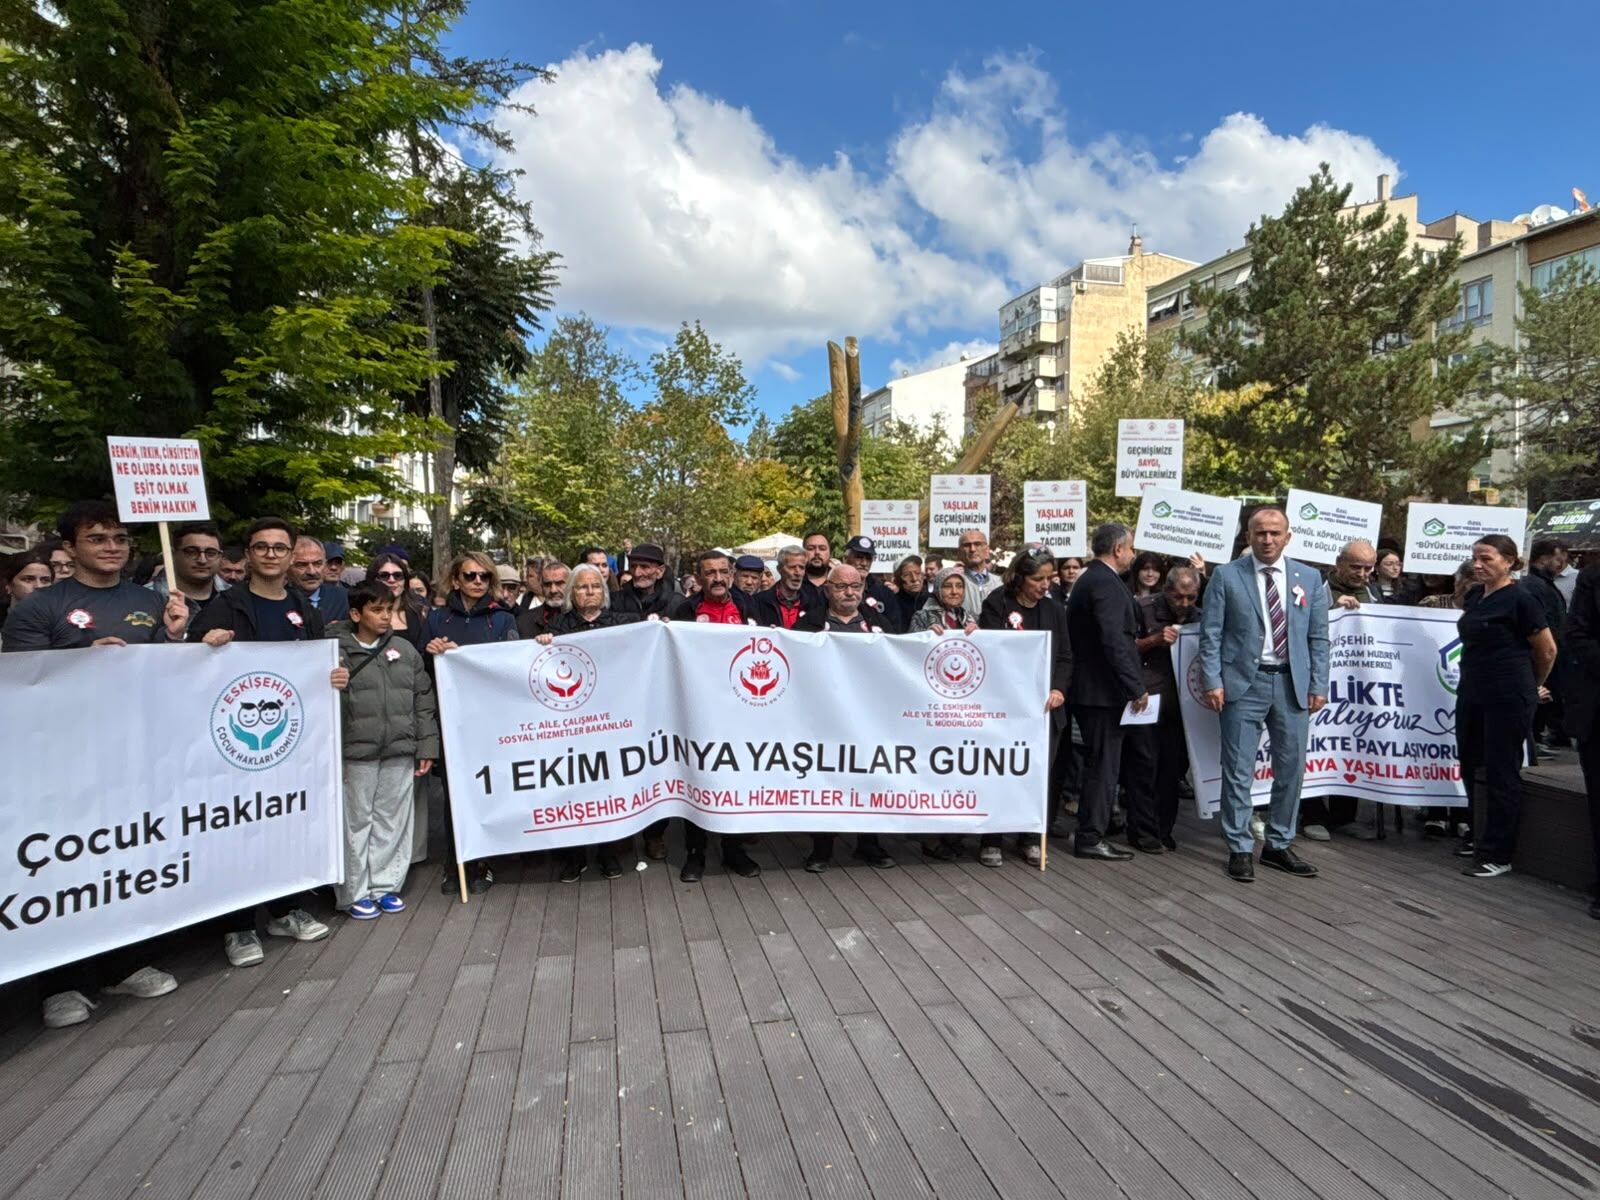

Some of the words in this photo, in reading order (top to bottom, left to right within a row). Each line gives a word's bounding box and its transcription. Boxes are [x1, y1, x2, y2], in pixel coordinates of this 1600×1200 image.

[1127, 445, 1173, 457] GEÇMİŞİMİZE
[116, 462, 130, 475] NE
[131, 463, 168, 475] OLURSA
[170, 463, 199, 476] OLSUN
[1121, 468, 1177, 479] BÜYÜKLERİMİZE
[134, 479, 155, 496] EŞİT
[157, 481, 189, 495] OLMAK
[131, 498, 160, 514] BENİM
[162, 501, 197, 513] HAKKIM
[942, 500, 978, 511] YAŞLILAR
[934, 513, 986, 525] GEÇMİŞİMİZİN
[1037, 508, 1074, 520] YAŞLILAR
[872, 526, 907, 537] YAŞLILAR
[1035, 522, 1075, 534] BAŞIMIZIN
[873, 540, 911, 549] OPLUMSAL
[1040, 537, 1071, 546] TACIDIR
[1303, 540, 1313, 548] EN
[1315, 541, 1337, 553] GÜÇLÜ
[1335, 649, 1364, 659] YAŞAM
[1332, 660, 1360, 668] BAKIM
[223, 676, 293, 704] ESKİŞEHİR
[1330, 675, 1405, 708] LİKTE
[942, 702, 982, 711] ESKİŞEHİR
[903, 710, 920, 718] AİLE
[965, 711, 1006, 719] HİZMETLER
[520, 723, 536, 731] T.C.
[563, 715, 598, 728] ÇALIŞMA
[600, 712, 611, 721] VE
[926, 718, 933, 727] İL
[935, 719, 983, 727] MÜDÜRLÜĞÜ
[498, 734, 534, 745] SOSYAL
[536, 726, 584, 740] HİZMETLER
[586, 719, 633, 734] BAKANLIĞI
[216, 726, 237, 757] ÇOCUK
[236, 752, 274, 765] HAKLARI
[274, 718, 299, 757] KOMİTESİ
[475, 765, 492, 795] 1
[511, 747, 610, 792] EKİM
[620, 729, 740, 777] DÜNYA
[745, 741, 917, 779] YAŞLILAR
[929, 740, 1030, 776] GÜNÜ
[1343, 758, 1422, 780] YAŞLILAR
[1423, 765, 1464, 782] GÜNÜ
[533, 794, 627, 825] ESKİŞEHİR
[631, 782, 661, 810] AİLE
[665, 779, 685, 795] VE
[687, 786, 743, 807] SOSYAL
[749, 785, 843, 806] HİZMETLER
[850, 788, 864, 807] İL
[870, 789, 976, 810] MÜDÜRLÜĞÜ
[17, 811, 166, 877] Çocuk
[181, 790, 306, 836] Hakları
